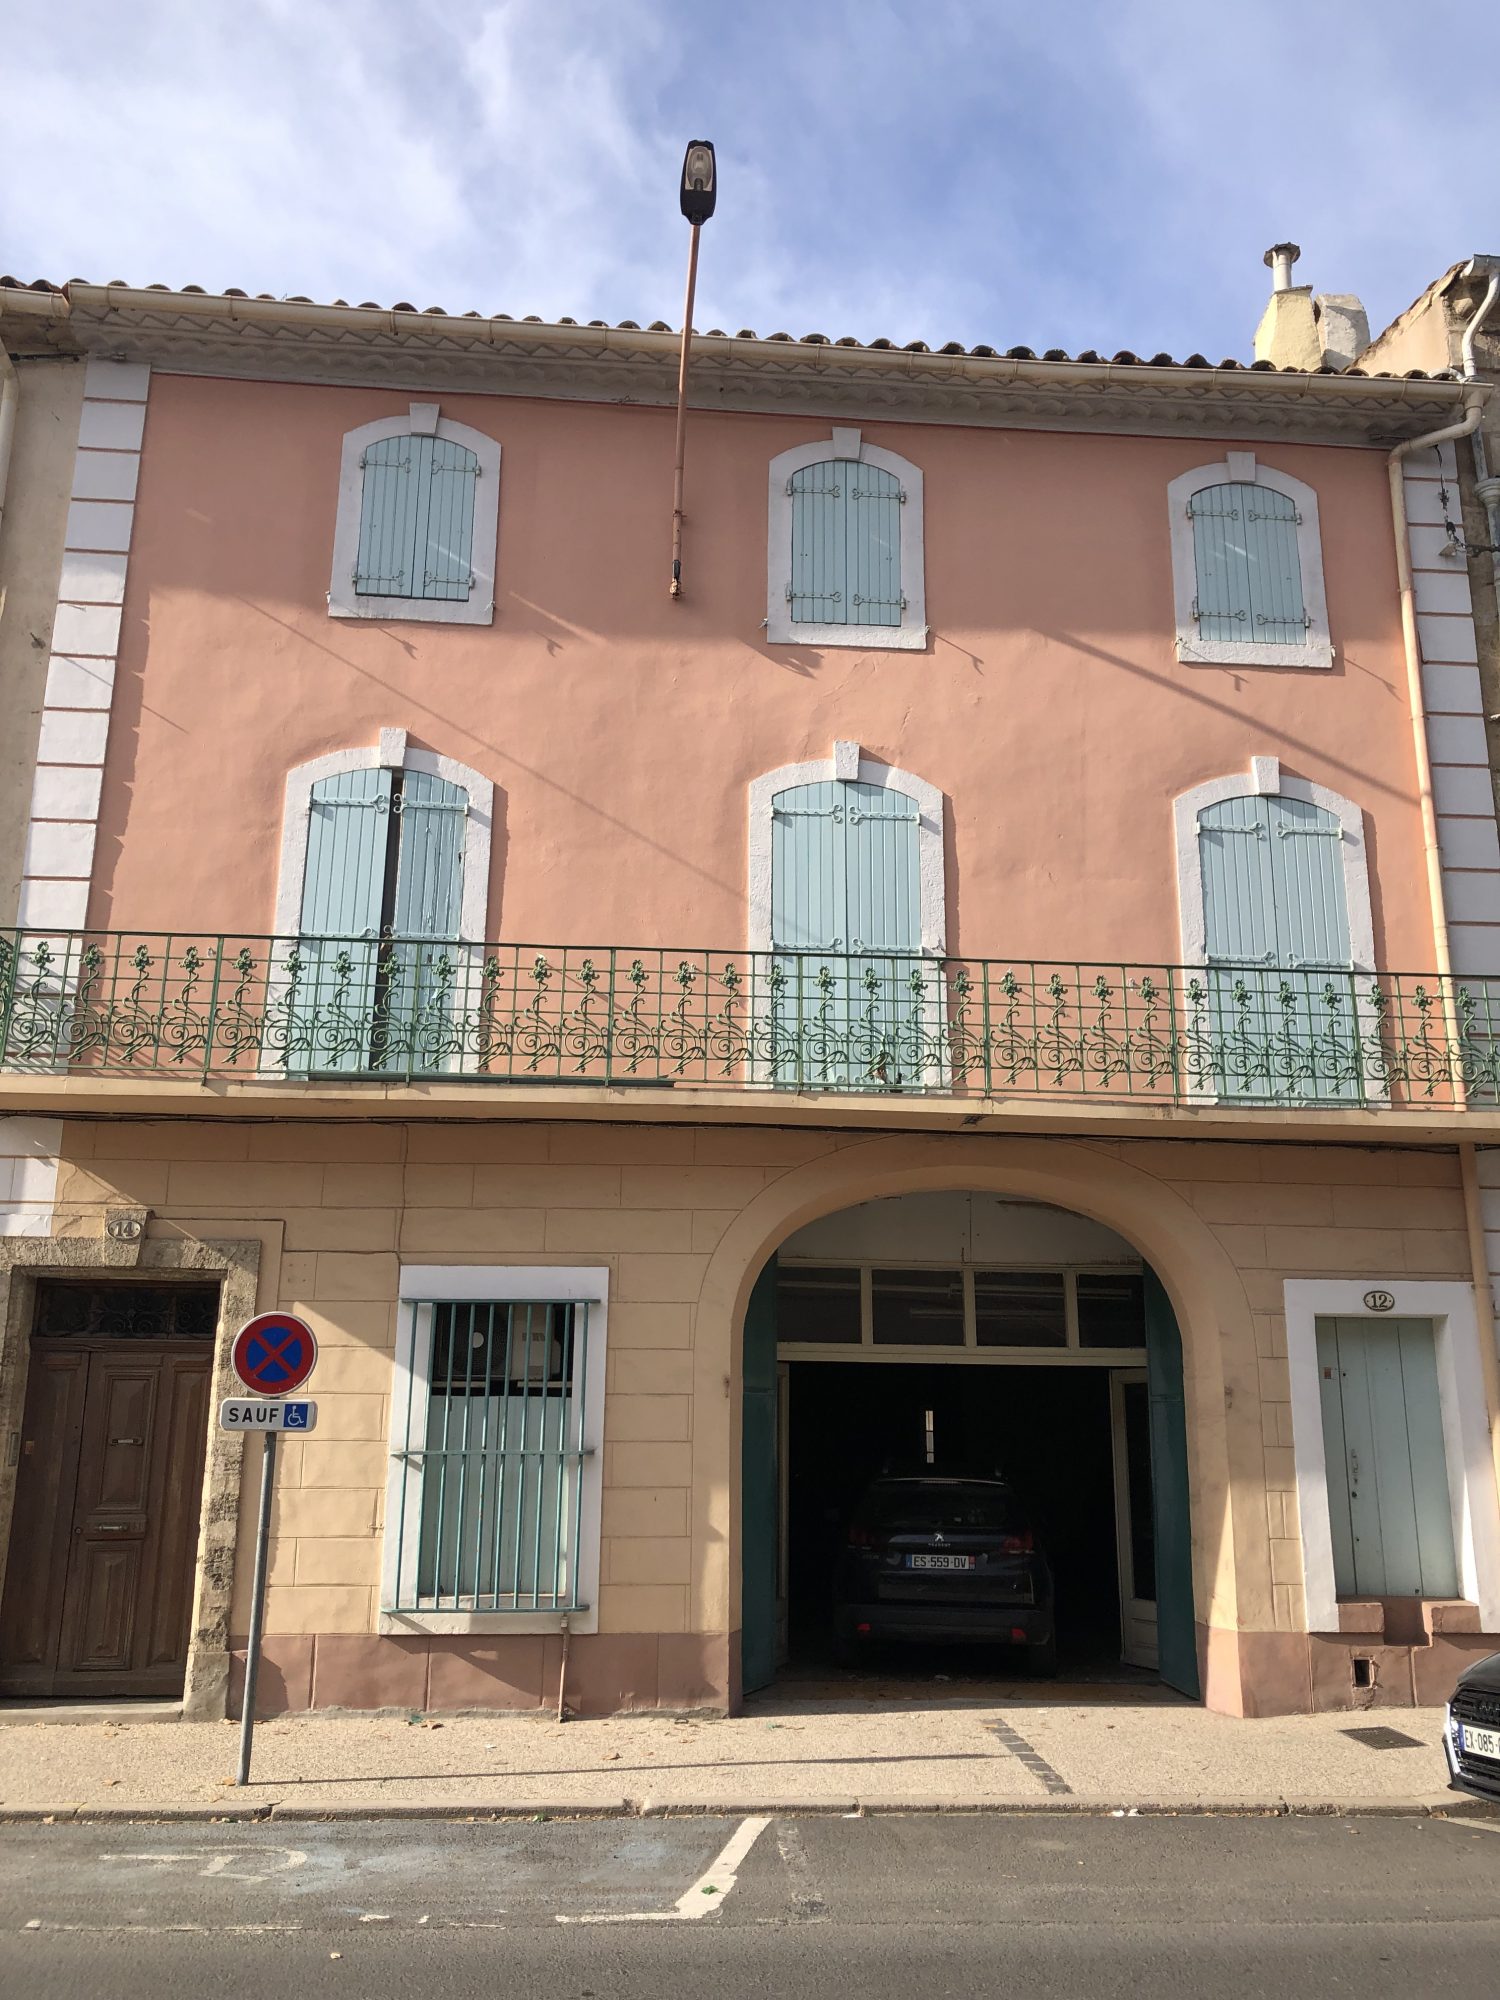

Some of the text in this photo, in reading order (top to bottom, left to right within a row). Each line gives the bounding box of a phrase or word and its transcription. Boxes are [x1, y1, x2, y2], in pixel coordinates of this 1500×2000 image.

[115, 1221, 133, 1237] 14
[1371, 1293, 1388, 1308] 12
[228, 1407, 279, 1423] SAUF
[1464, 1730, 1500, 1753] EX-085-
